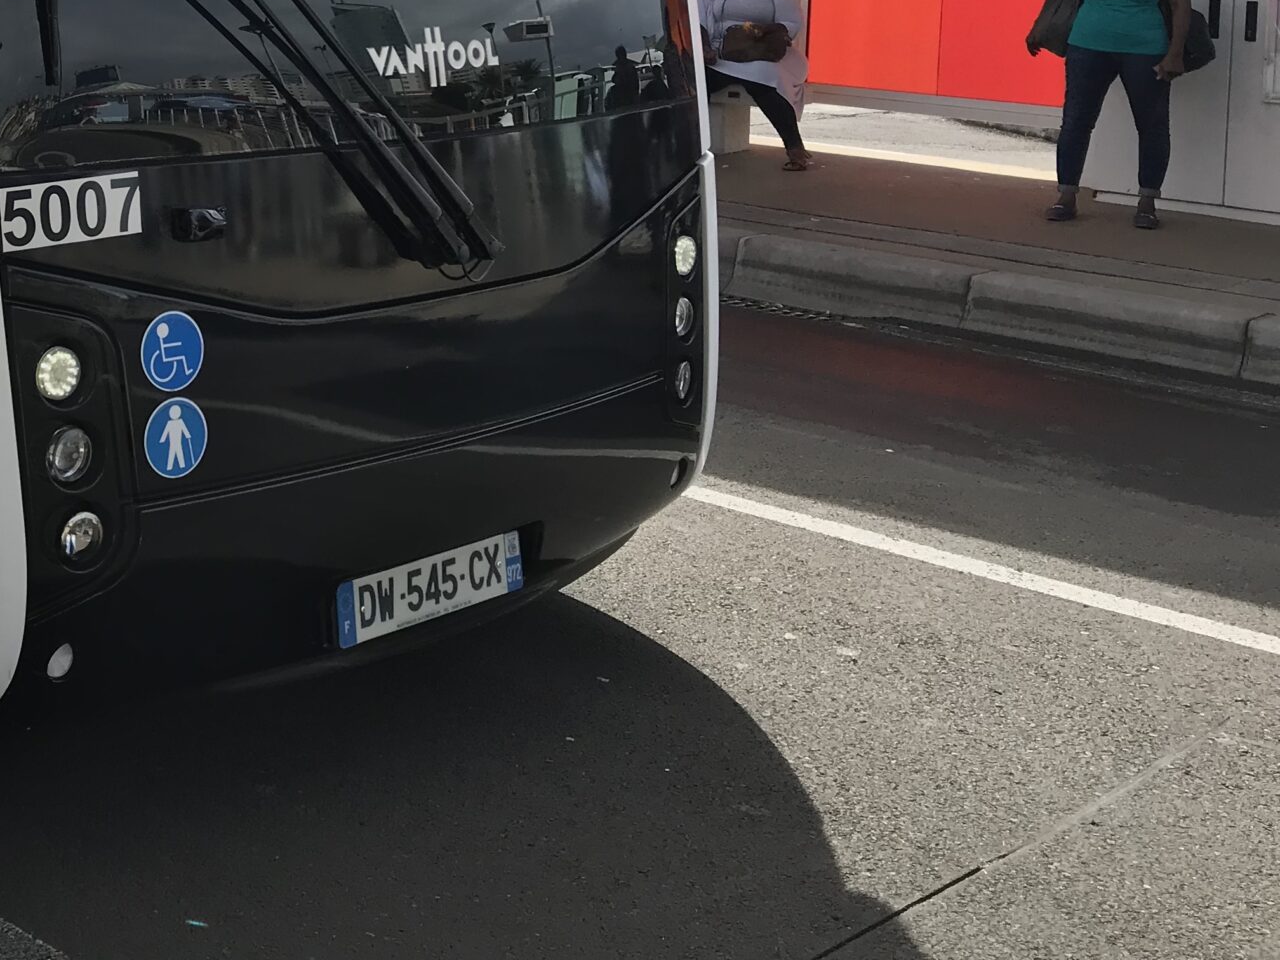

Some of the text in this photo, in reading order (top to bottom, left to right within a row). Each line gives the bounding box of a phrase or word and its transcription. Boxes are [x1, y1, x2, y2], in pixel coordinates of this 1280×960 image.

[3, 177, 140, 247] 5007
[507, 563, 522, 583] 972
[344, 620, 351, 635] F
